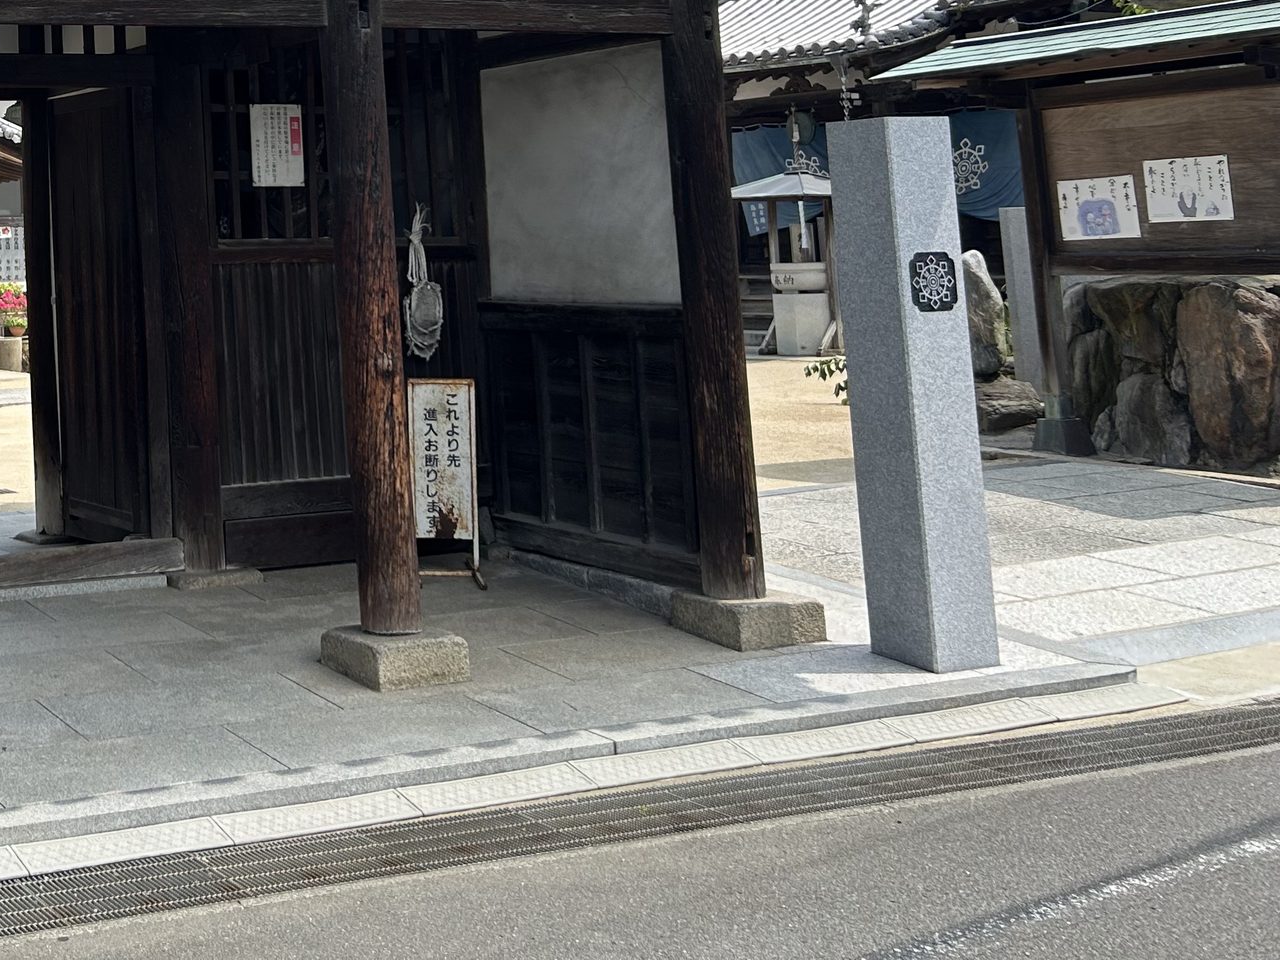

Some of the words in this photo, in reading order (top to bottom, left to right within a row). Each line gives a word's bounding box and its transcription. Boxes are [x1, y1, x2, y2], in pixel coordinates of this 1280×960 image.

[446, 393, 461, 467] これより先
